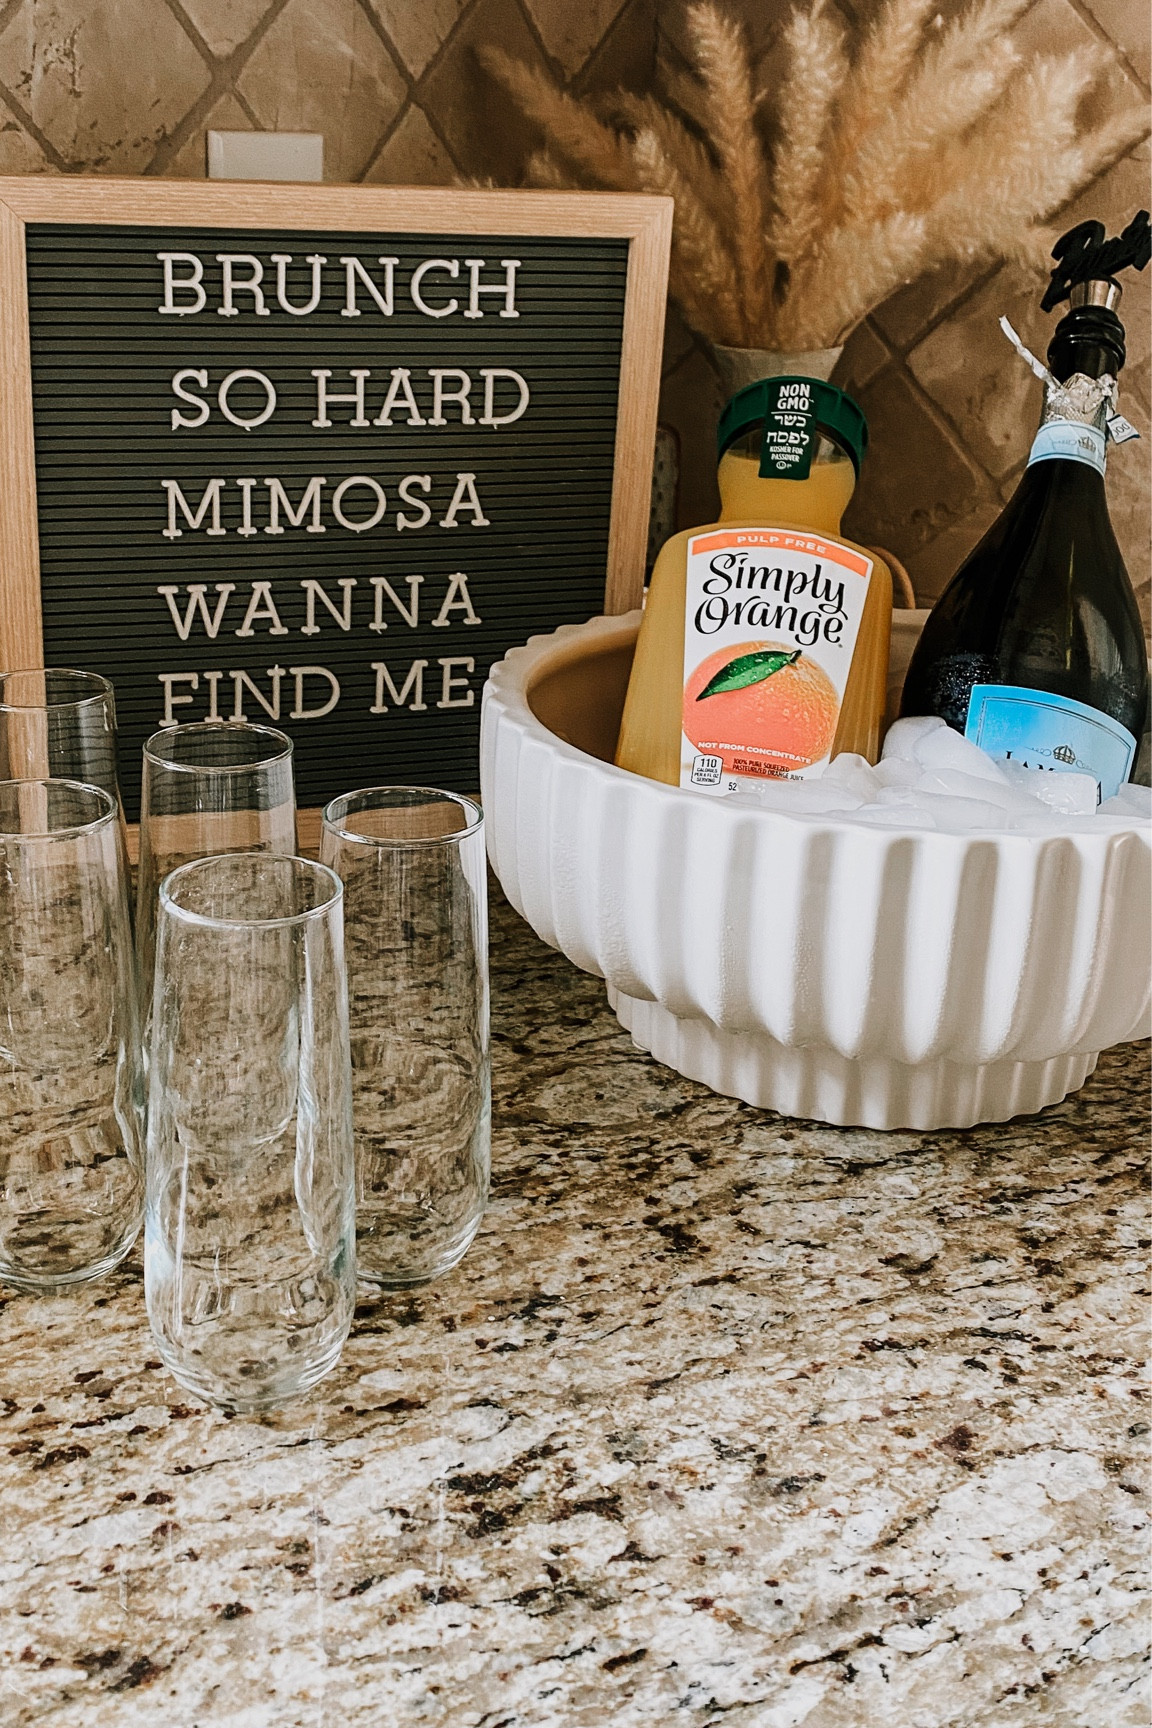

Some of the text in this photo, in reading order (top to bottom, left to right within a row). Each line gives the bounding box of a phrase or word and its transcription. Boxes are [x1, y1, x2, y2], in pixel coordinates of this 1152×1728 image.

[156, 252, 522, 318] BRUNCH
[171, 367, 530, 430] SO HARD
[779, 383, 811, 398] NON
[769, 445, 804, 455] KOSHER FOR
[770, 453, 801, 463] PASSOVER
[161, 473, 491, 539] MIMOSA
[737, 535, 827, 555] PULP FREE
[702, 552, 848, 621] Simply
[157, 573, 482, 640] WANNA
[694, 595, 844, 647] Orange
[158, 657, 475, 727] FIND ME
[698, 742, 811, 764] NOT FROM CONCENTRATE
[700, 758, 718, 768] 110
[732, 764, 767, 775] PASTEURIZED
[767, 769, 789, 780] ORANGE
[763, 762, 790, 773] SQUEEZED
[728, 781, 738, 791] 52
